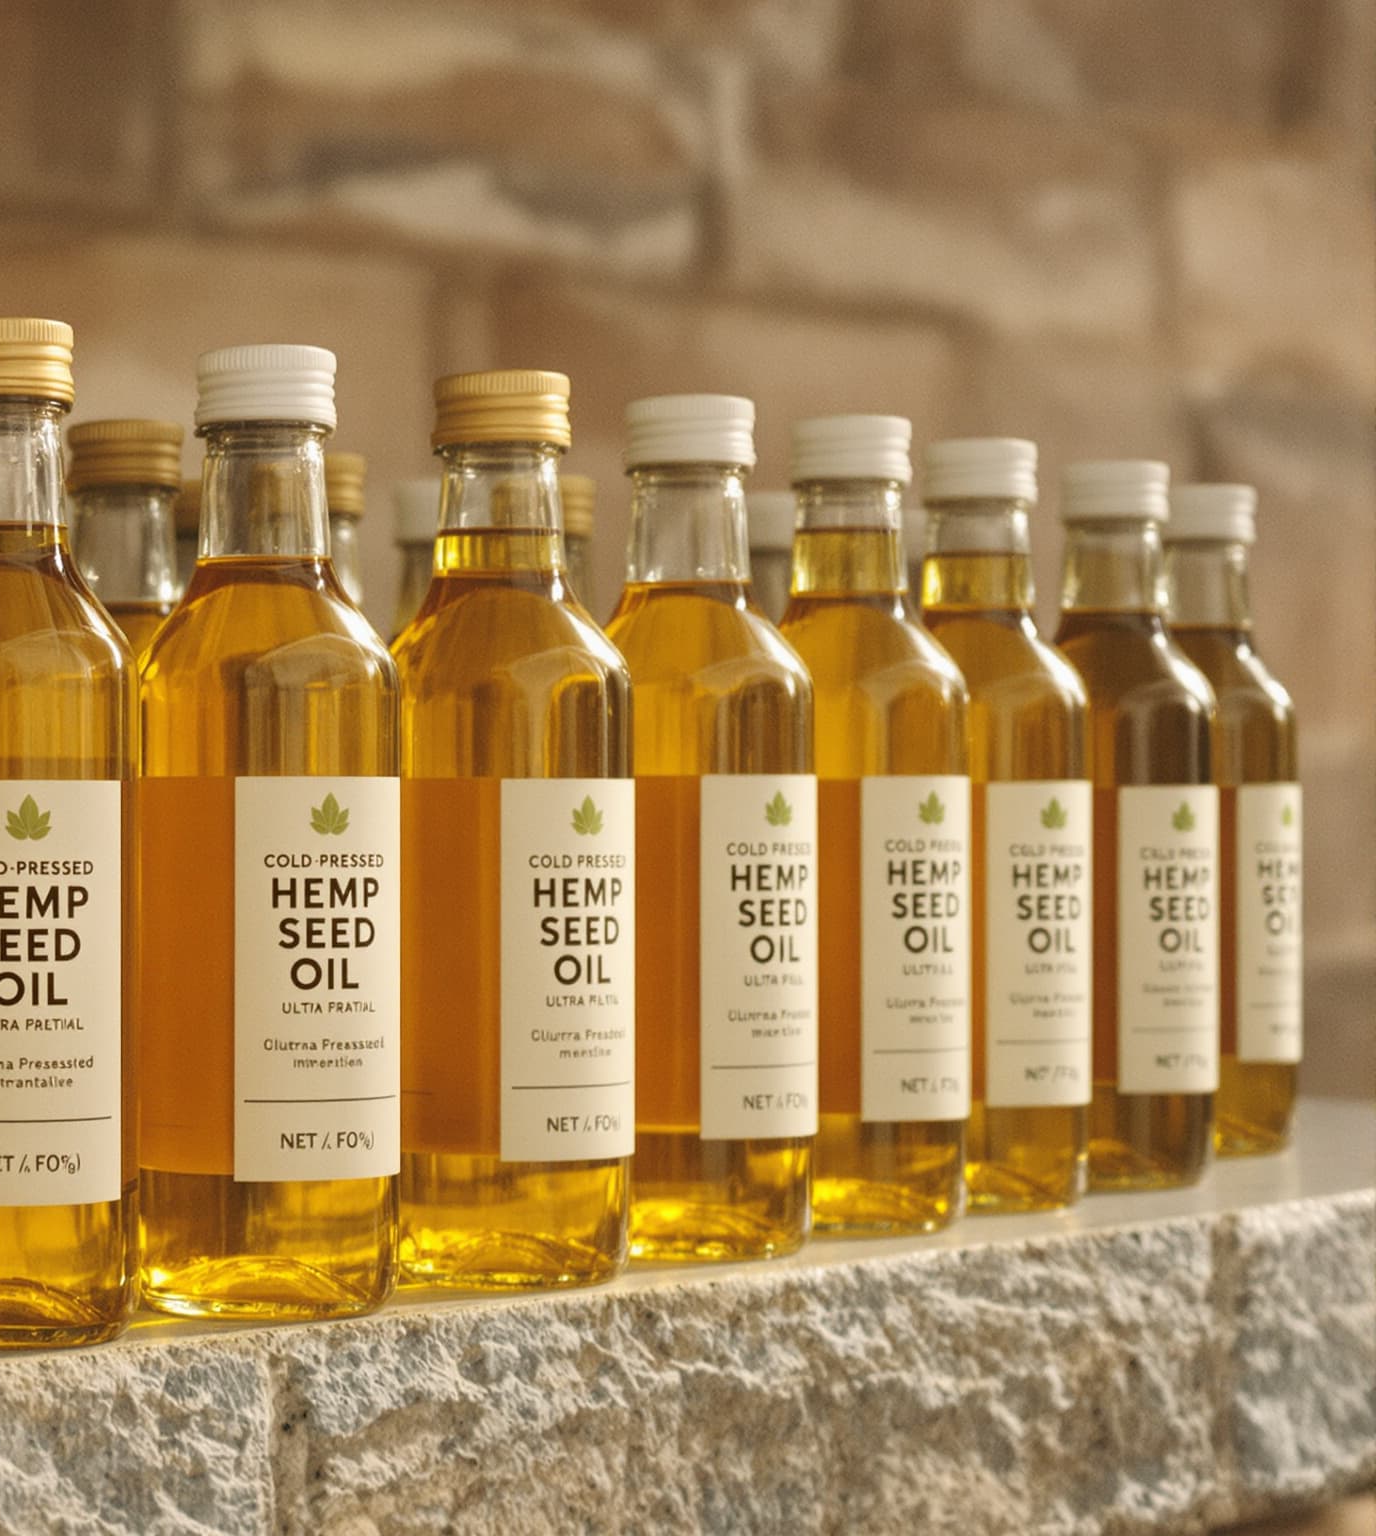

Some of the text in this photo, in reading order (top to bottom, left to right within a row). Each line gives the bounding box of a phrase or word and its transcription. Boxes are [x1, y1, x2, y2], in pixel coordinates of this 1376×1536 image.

[263, 855, 384, 868] COLD-PRESSED
[529, 855, 572, 868] COLD
[727, 842, 768, 856] COLD
[731, 864, 808, 891] HEMP
[888, 860, 961, 886] HEMP
[1012, 864, 1081, 889] HEMP
[272, 877, 379, 908] HEMP
[534, 878, 622, 908] HEMP
[892, 892, 959, 918] SEED
[738, 899, 807, 927] SEED
[1017, 894, 1080, 921] SEED
[1150, 896, 1209, 922] SEED
[278, 918, 375, 948] SEED
[541, 916, 619, 946] SEED
[904, 926, 953, 953] OIL
[1028, 927, 1075, 954] OIL
[1160, 928, 1202, 953] OIL
[750, 935, 800, 964] OIL
[290, 957, 359, 990] OIL
[554, 954, 611, 985] OIL
[546, 995, 584, 1007] ULTRA
[743, 1095, 773, 1110] NET
[547, 1117, 579, 1132] NET
[280, 1133, 317, 1149] NET
